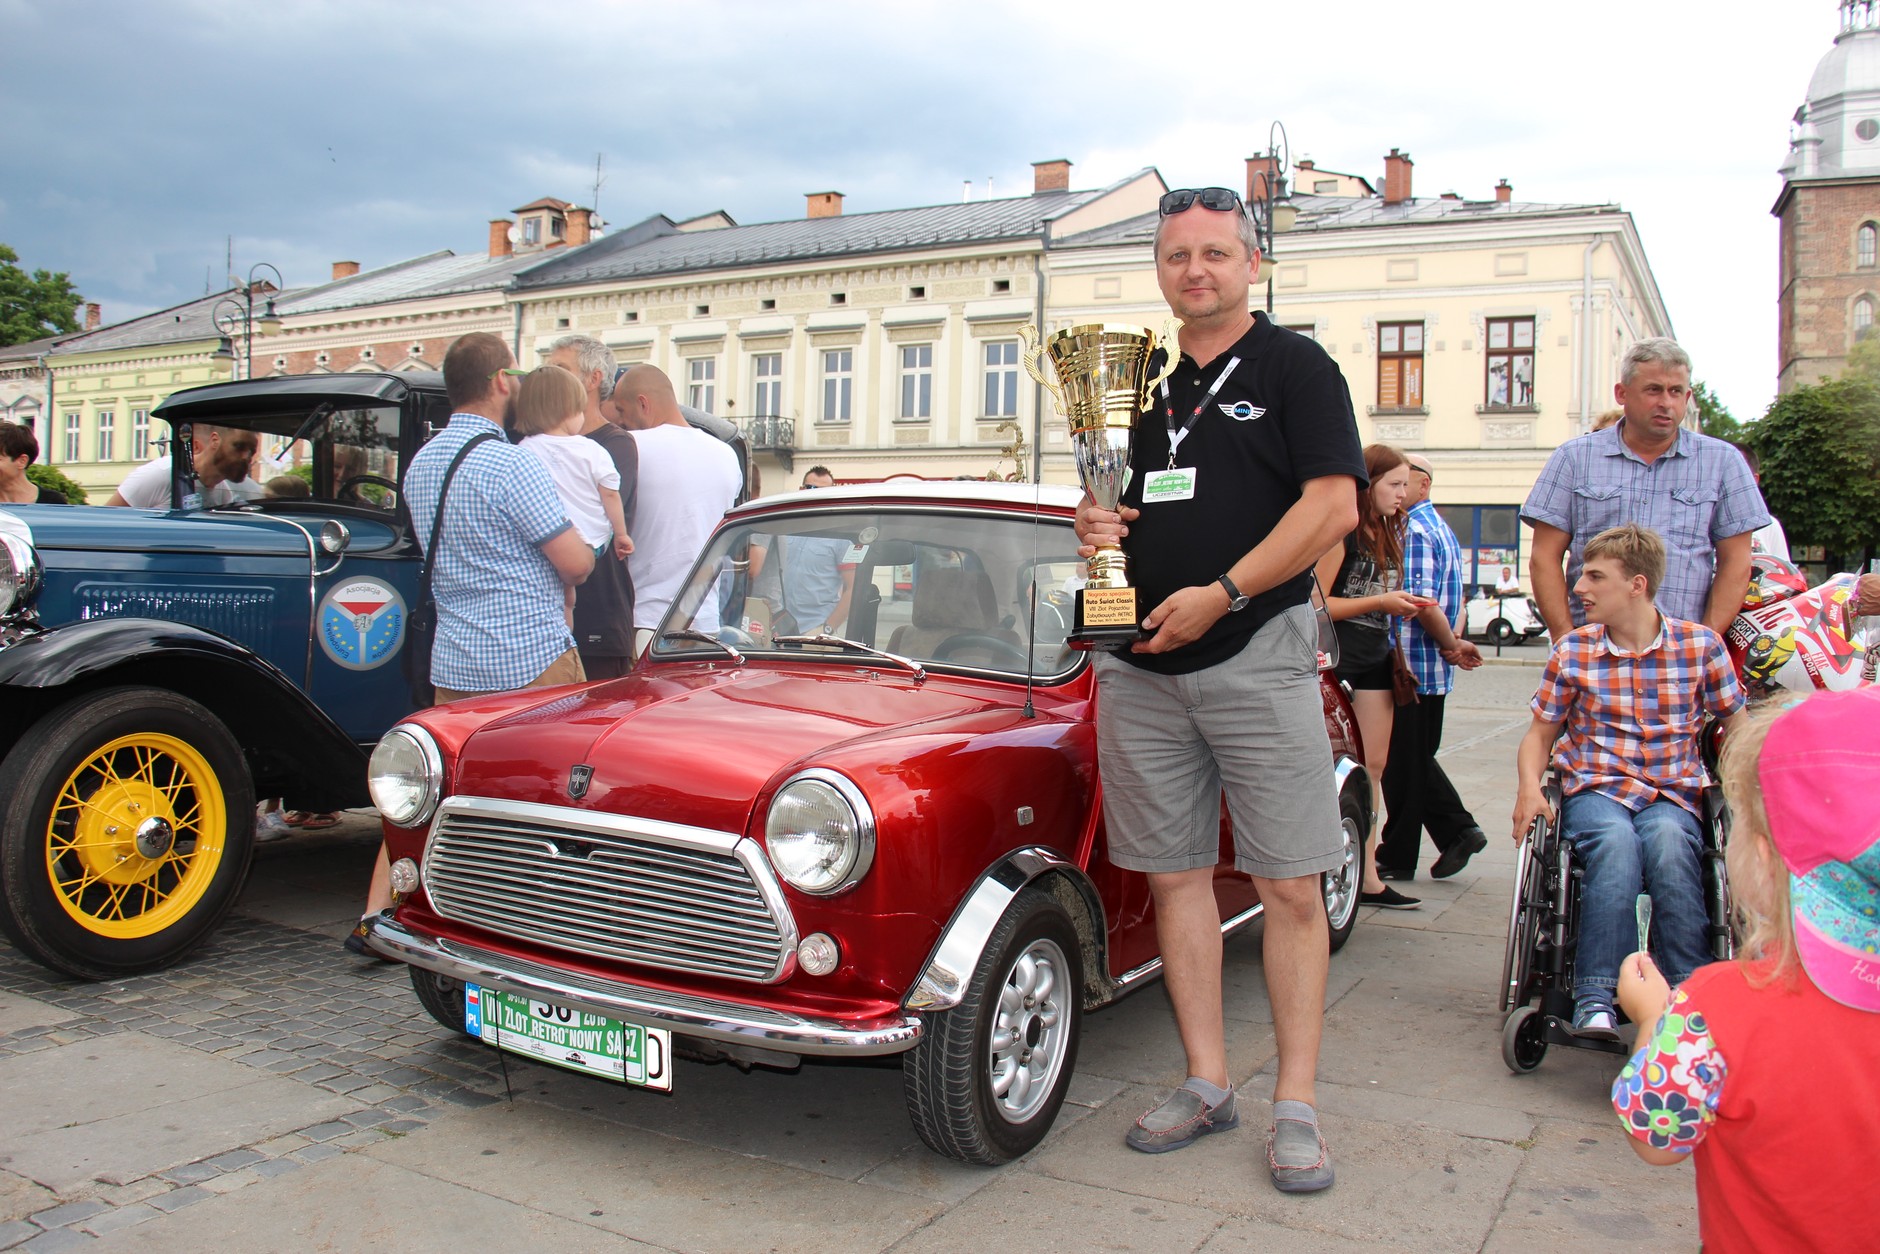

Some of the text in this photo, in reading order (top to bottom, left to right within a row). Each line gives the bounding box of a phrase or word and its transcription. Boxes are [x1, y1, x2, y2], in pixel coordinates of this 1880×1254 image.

[346, 585, 381, 595] Asocjacja
[1733, 618, 1756, 638] SPORT
[326, 622, 350, 659] Europejska
[1801, 653, 1818, 676] SPORT
[468, 1012, 479, 1027] PL
[505, 1006, 528, 1034] ZLOT
[570, 1029, 603, 1052] NOWY
